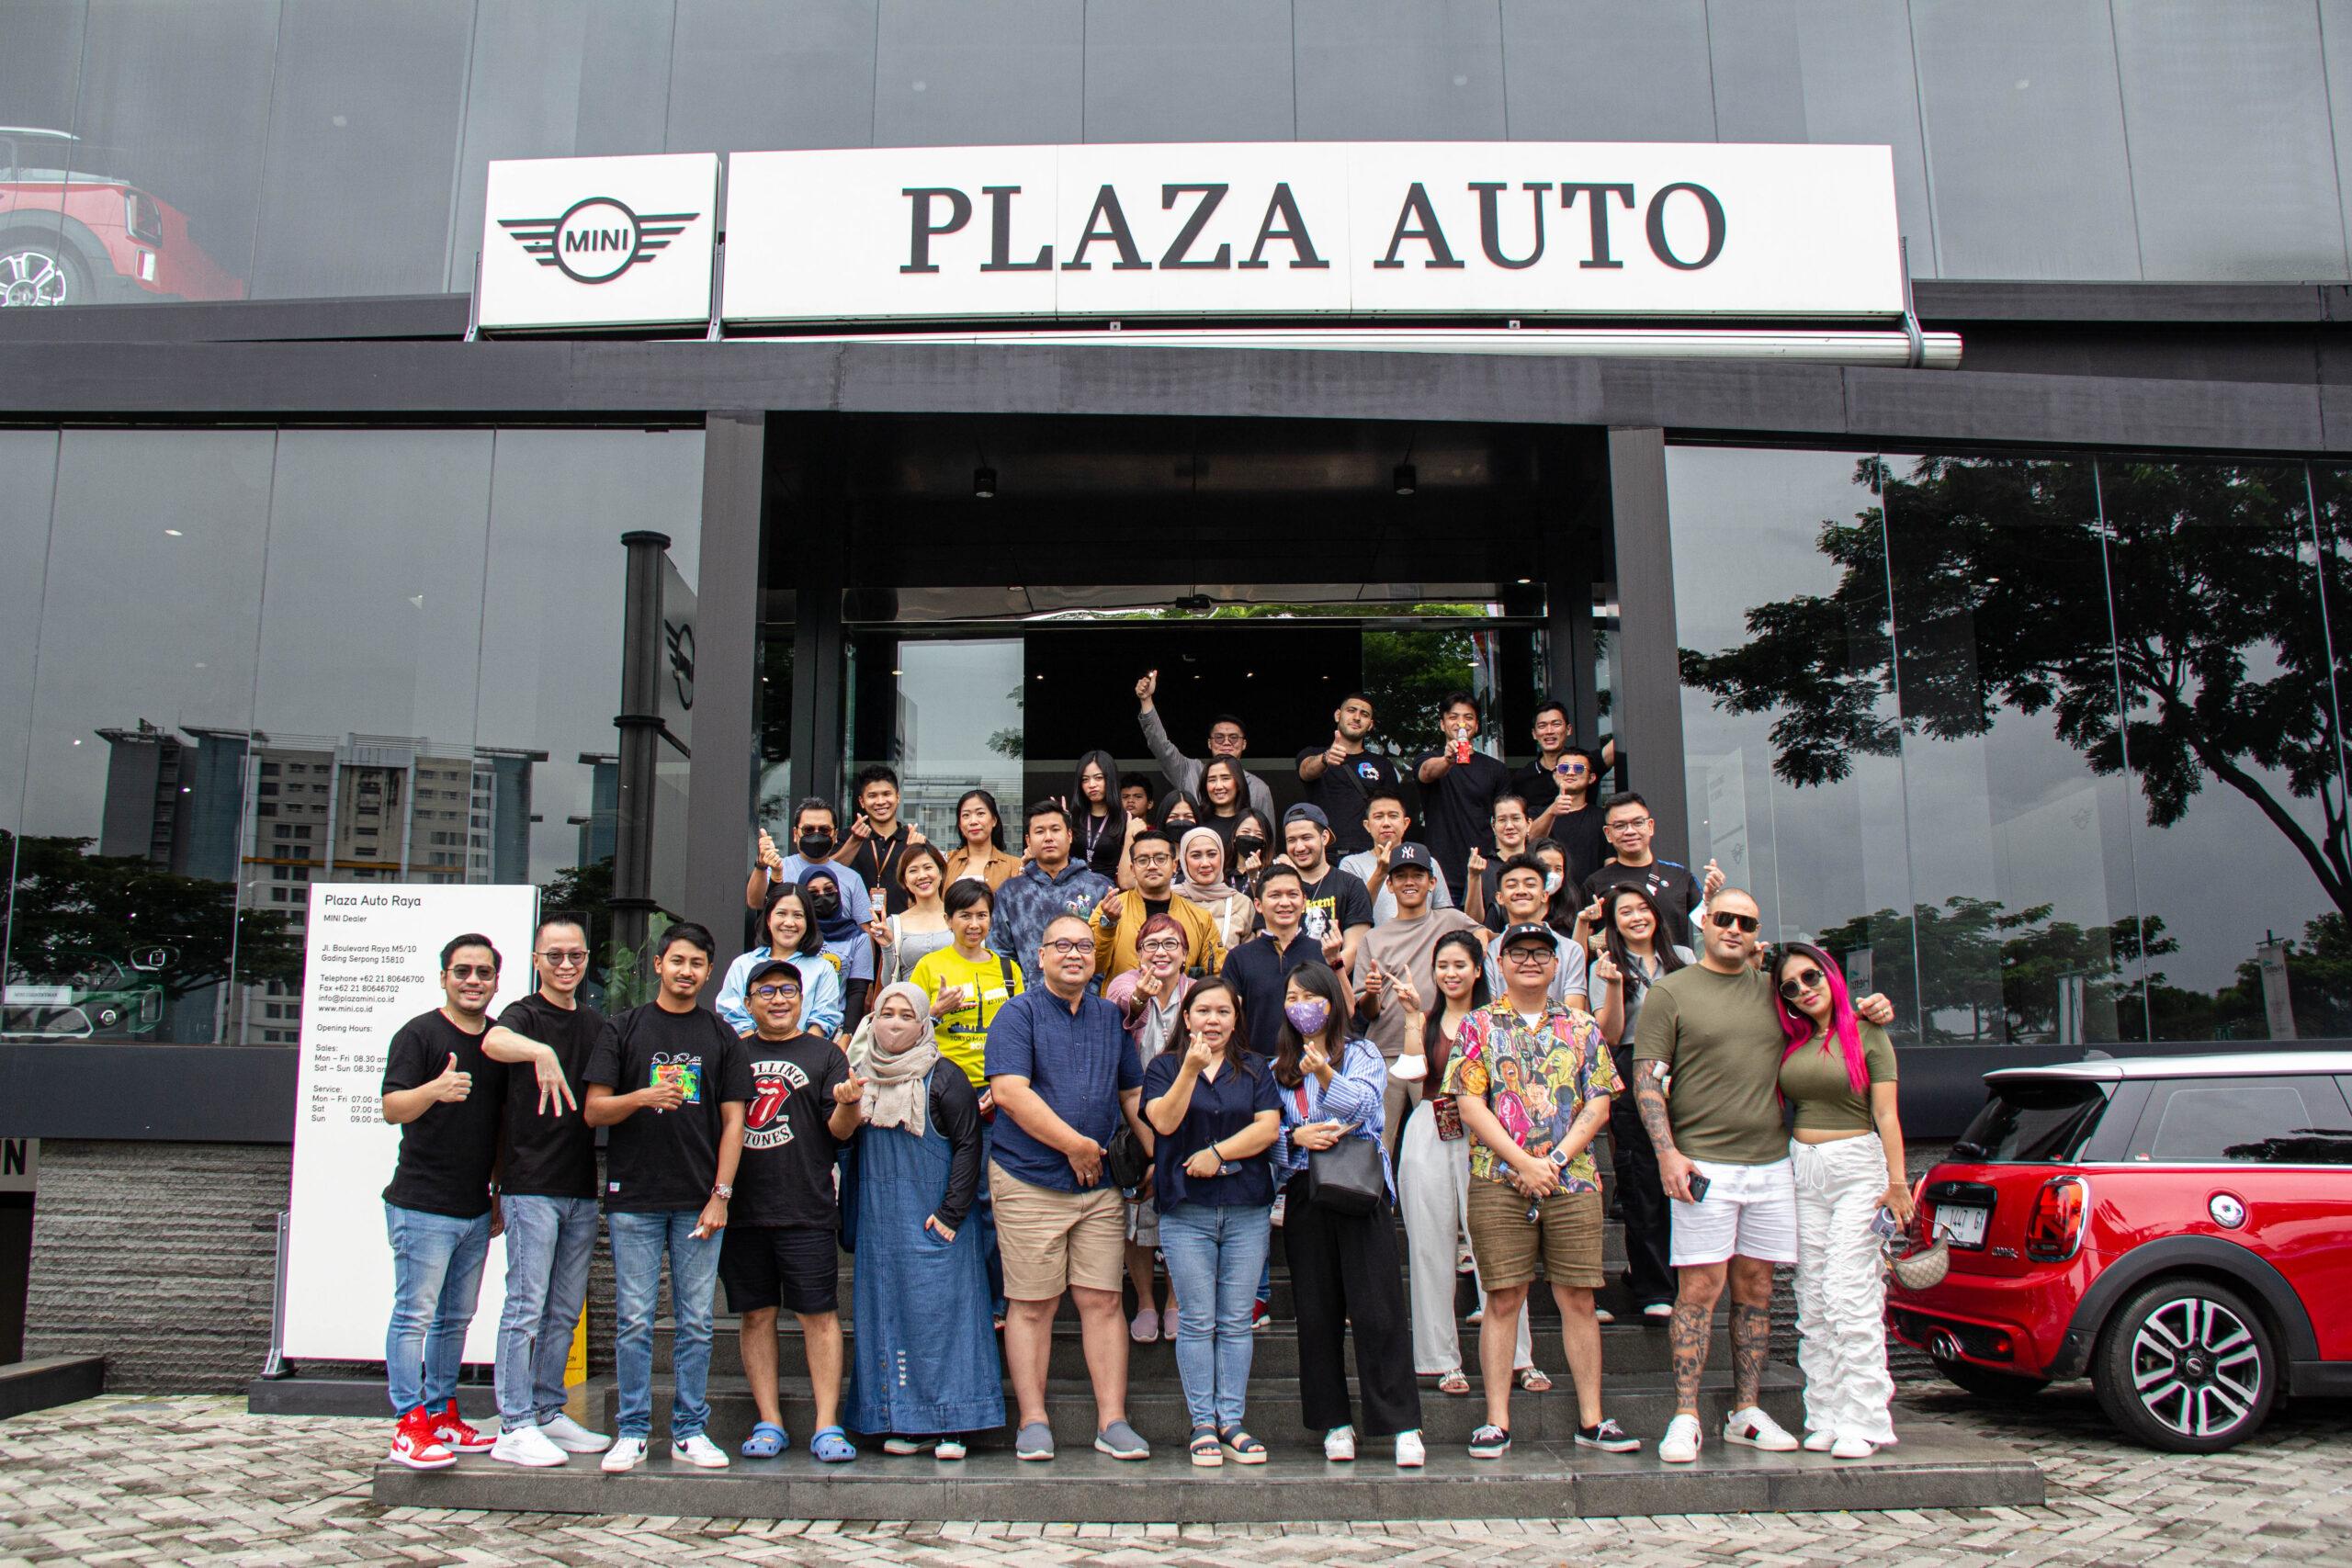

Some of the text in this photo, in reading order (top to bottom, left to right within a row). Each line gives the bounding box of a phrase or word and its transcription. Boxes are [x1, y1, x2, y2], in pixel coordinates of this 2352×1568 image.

[900, 183, 1725, 273] PLAZA AUTO
[566, 229, 628, 253] MINI
[325, 895, 421, 908] Plaza Auto Raya
[343, 915, 367, 923] Dealer
[333, 944, 369, 953] Boulevard
[371, 945, 390, 954] Raya
[392, 945, 416, 953] M5/10
[322, 954, 404, 964] Gading Serpong 15810
[321, 975, 357, 984] Telephone
[387, 976, 424, 984] 80646700
[362, 985, 399, 993] 80646702
[317, 1024, 346, 1033] Opening
[316, 1043, 338, 1053] Sales:
[314, 1085, 342, 1093] Service:
[352, 1096, 372, 1104] 07.00
[352, 1106, 372, 1114] 07.00
[311, 1114, 325, 1122] Sun
[351, 1115, 371, 1123] 09.00
[745, 1126, 791, 1146] TONES
[0, 1139, 27, 1175] N
